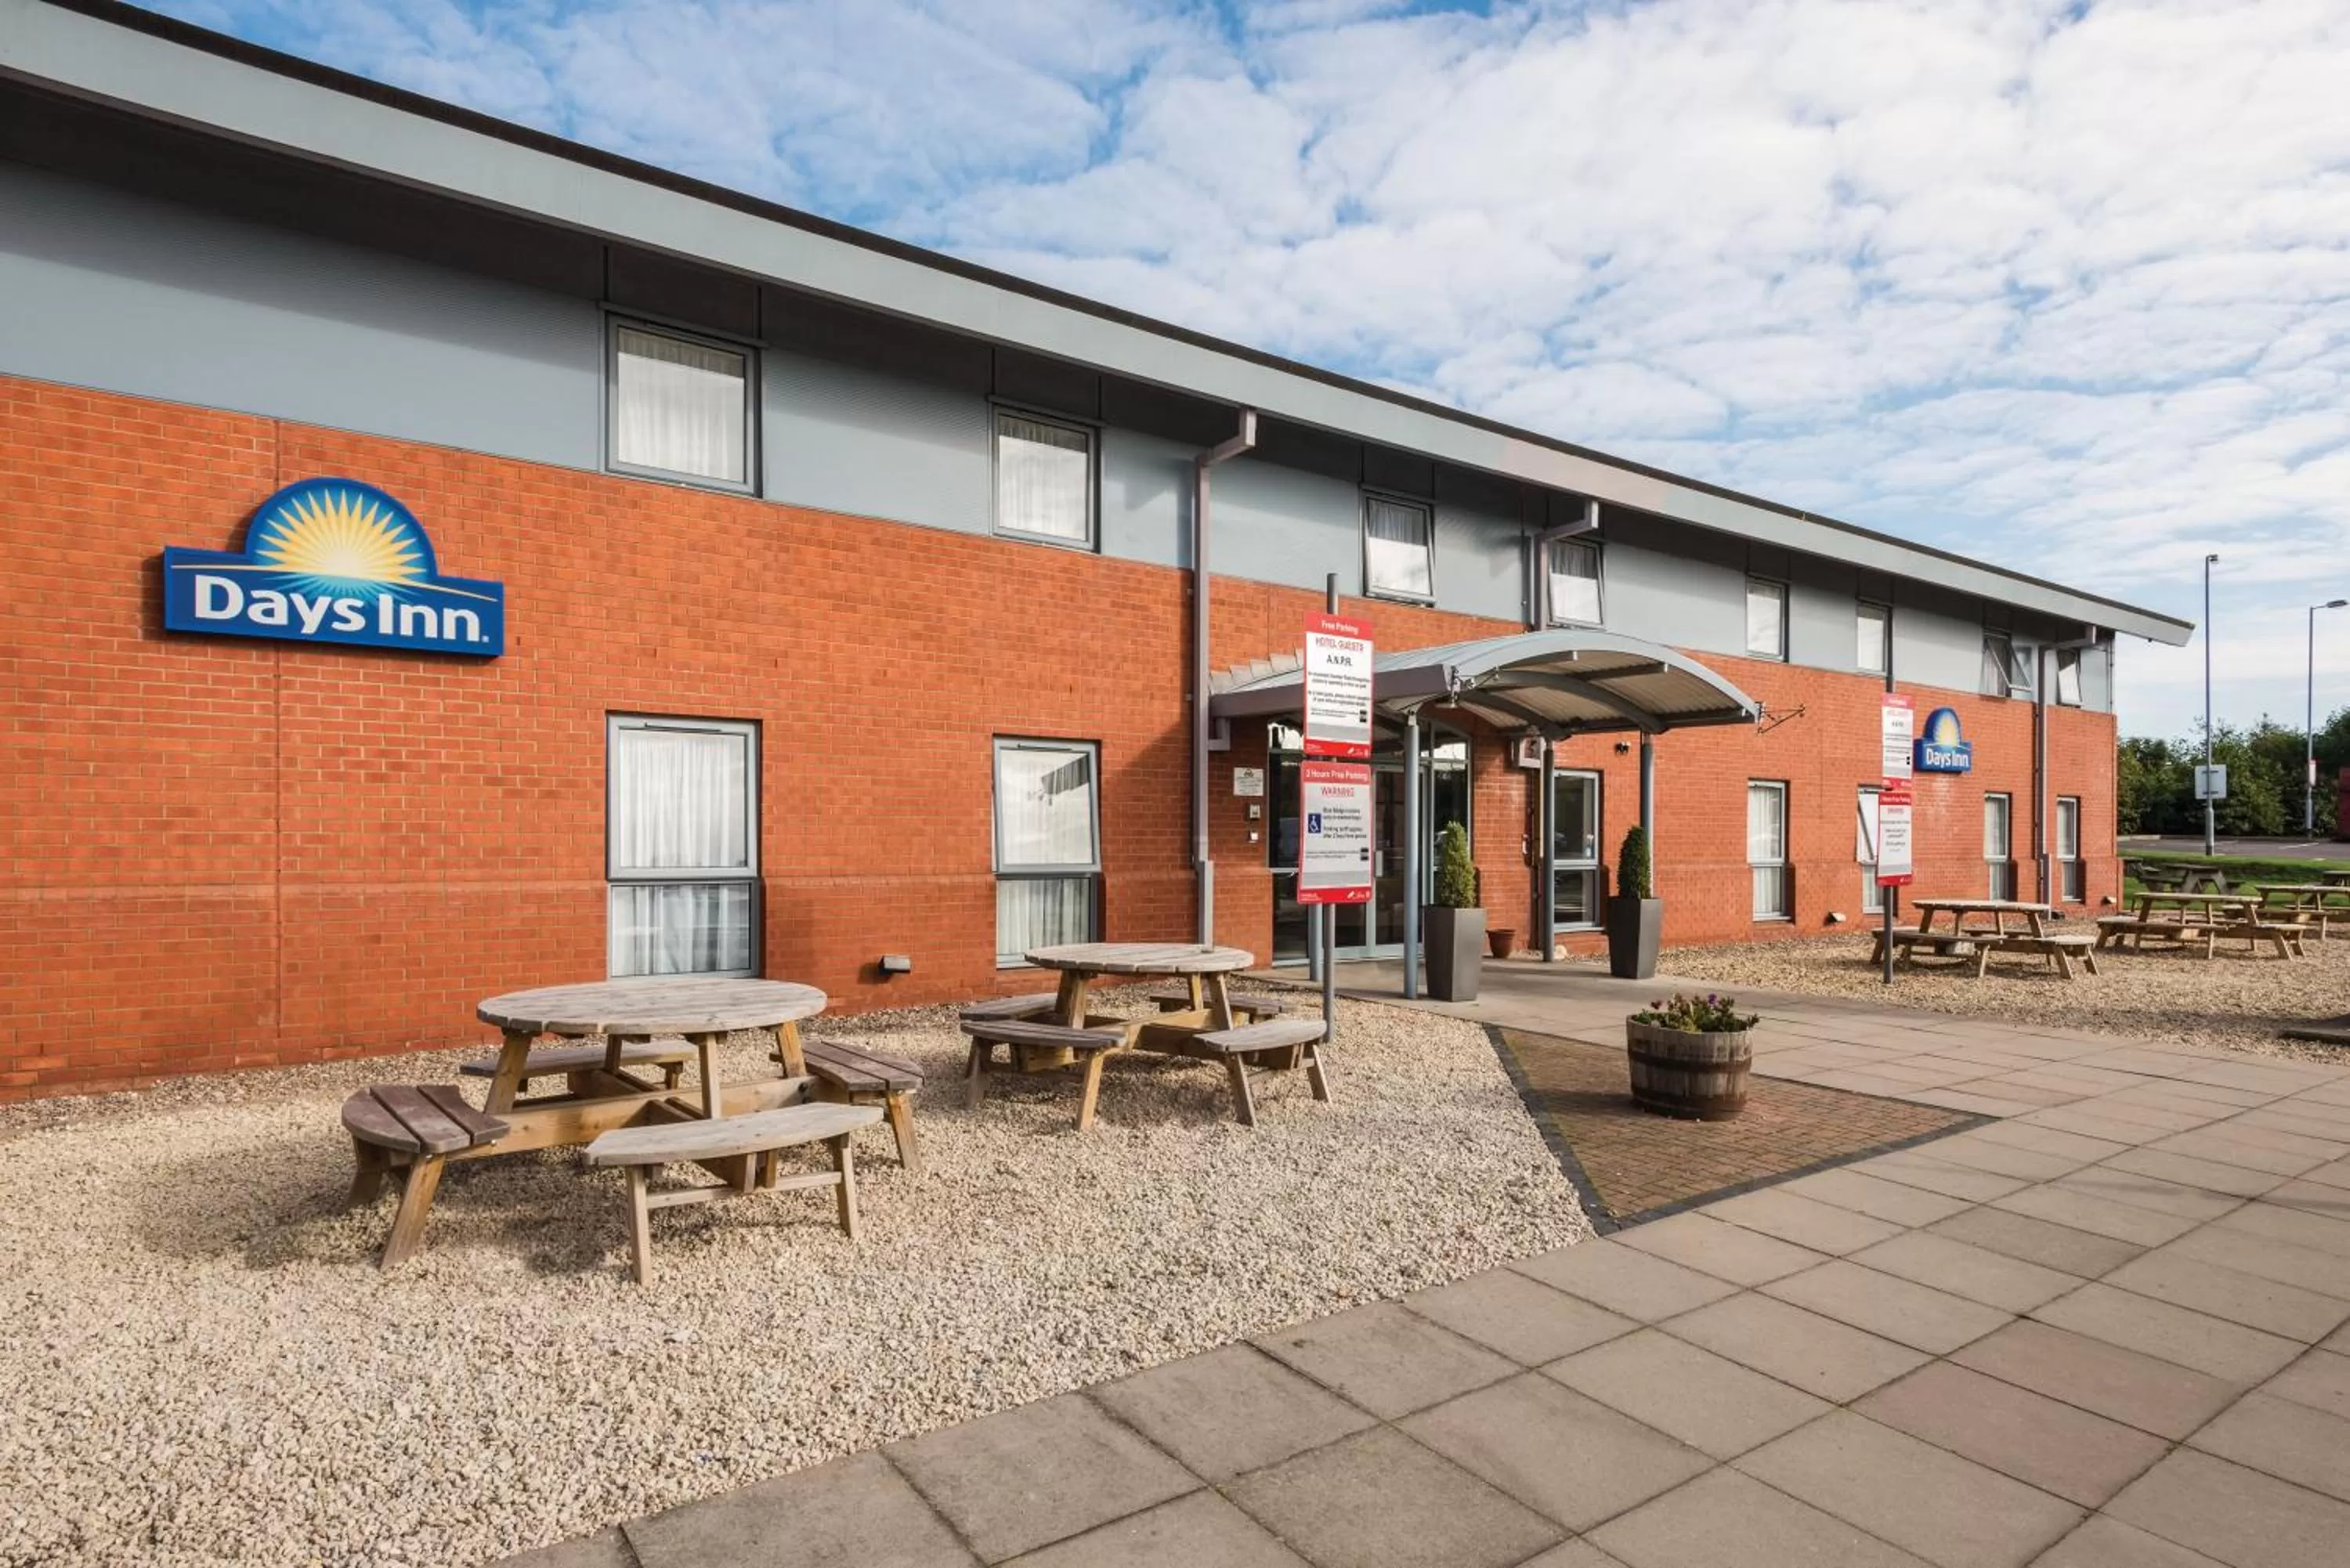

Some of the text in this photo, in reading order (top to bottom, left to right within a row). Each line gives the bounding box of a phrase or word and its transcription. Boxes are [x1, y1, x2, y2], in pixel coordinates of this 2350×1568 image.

[194, 574, 367, 634] Days
[1321, 620, 1360, 636] Free Parking
[1315, 637, 1336, 649] HOTEL
[1926, 747, 1951, 768] Days
[1331, 770, 1344, 779] Free
[1321, 786, 1354, 797] WARNING
